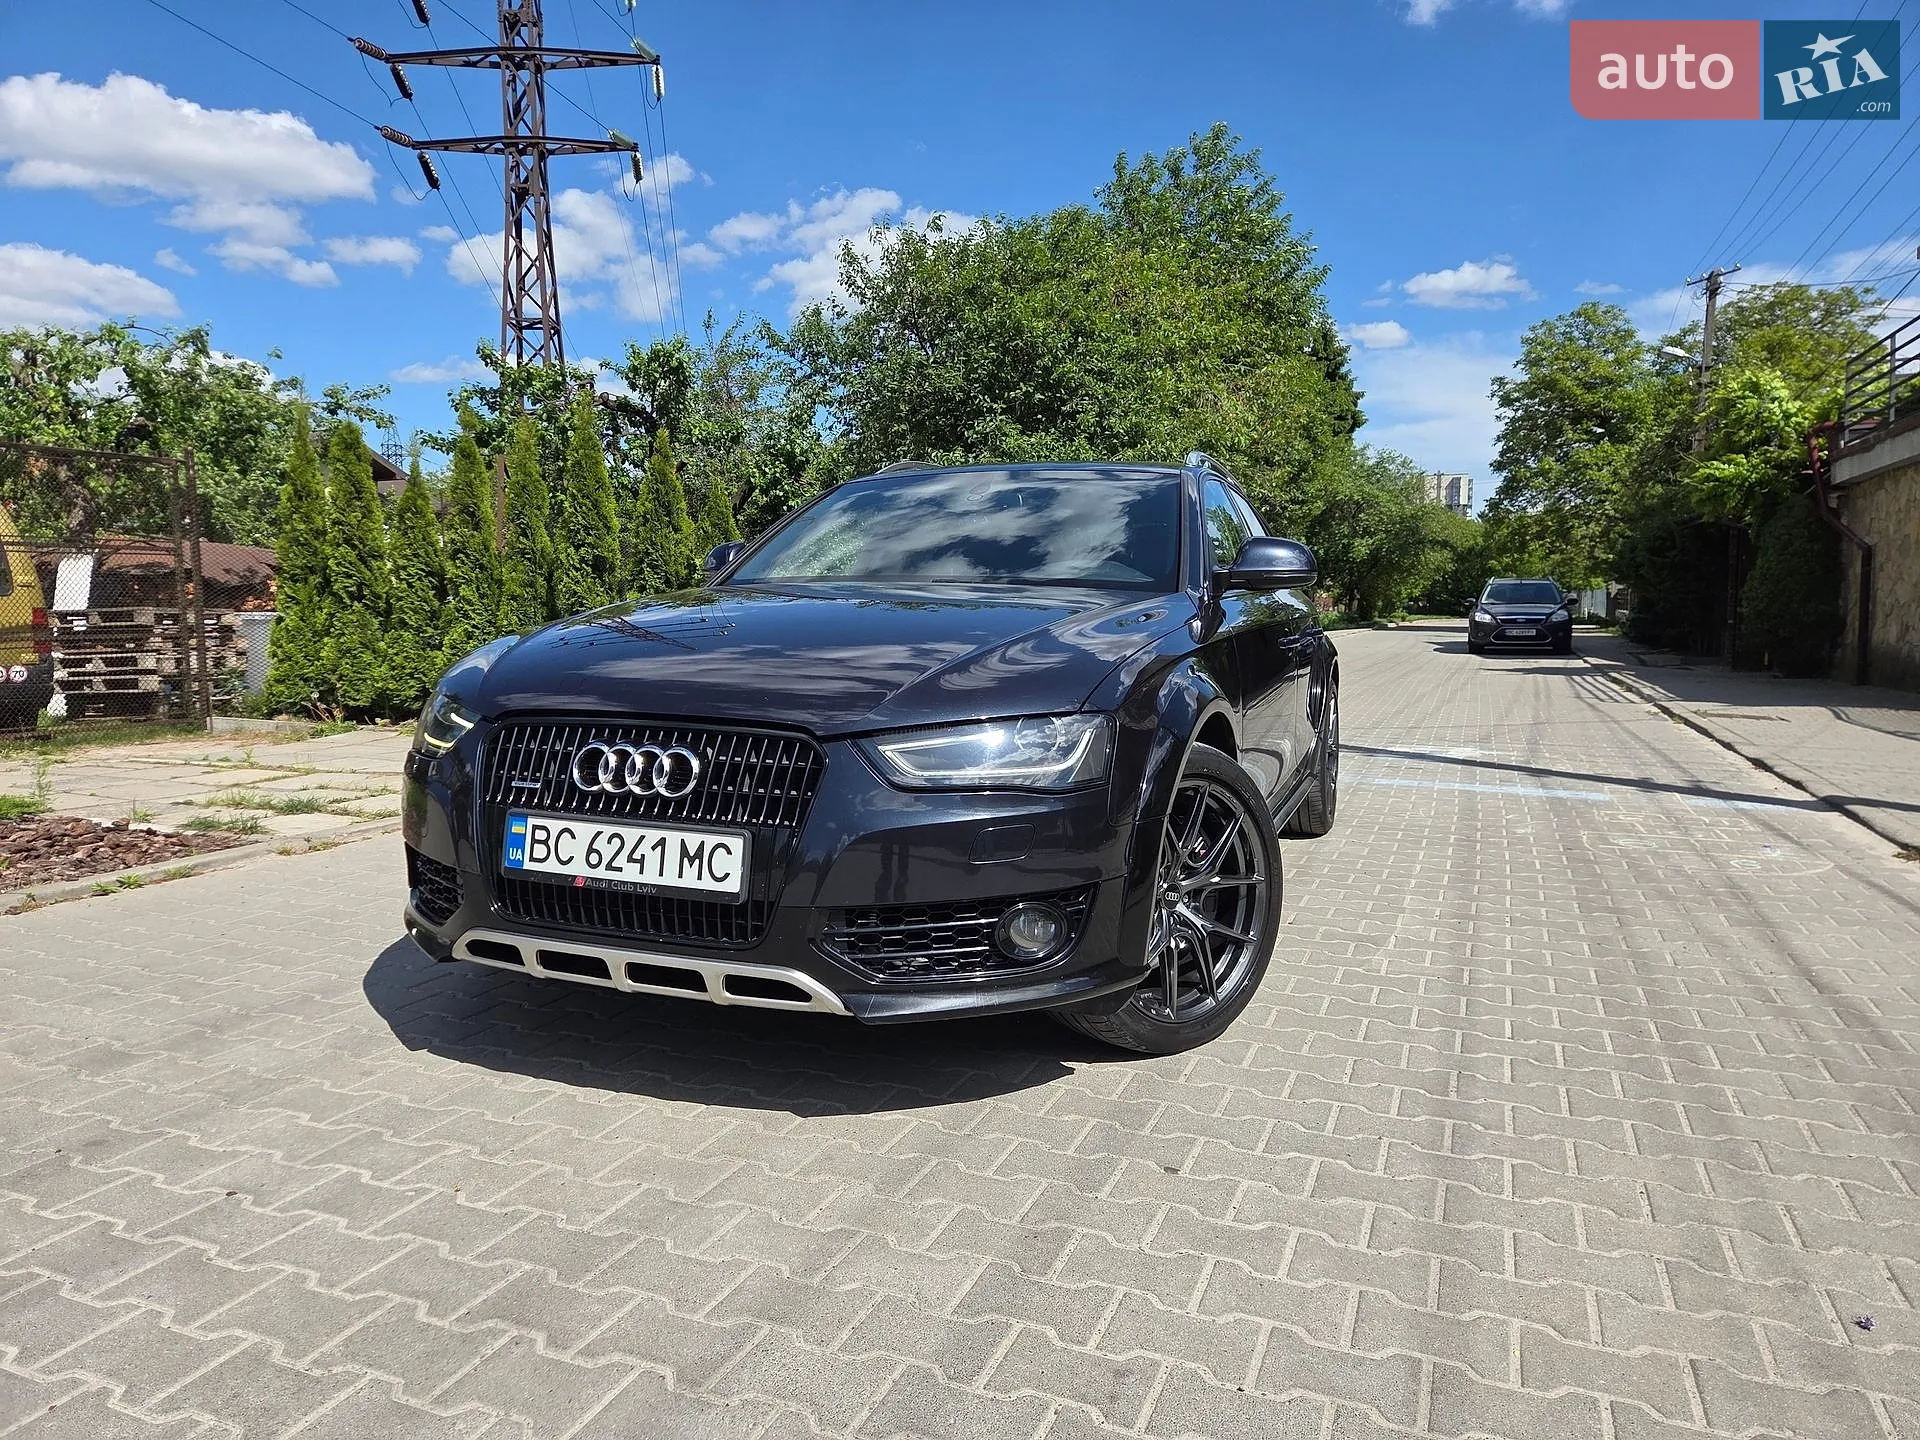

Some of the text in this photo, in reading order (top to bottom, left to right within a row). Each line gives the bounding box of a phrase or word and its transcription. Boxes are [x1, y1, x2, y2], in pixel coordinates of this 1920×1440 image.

[12, 670, 25, 678] 70
[509, 848, 523, 861] UA
[528, 824, 733, 883] BC 6241 MC
[585, 878, 657, 894] Audi Club Lviv
